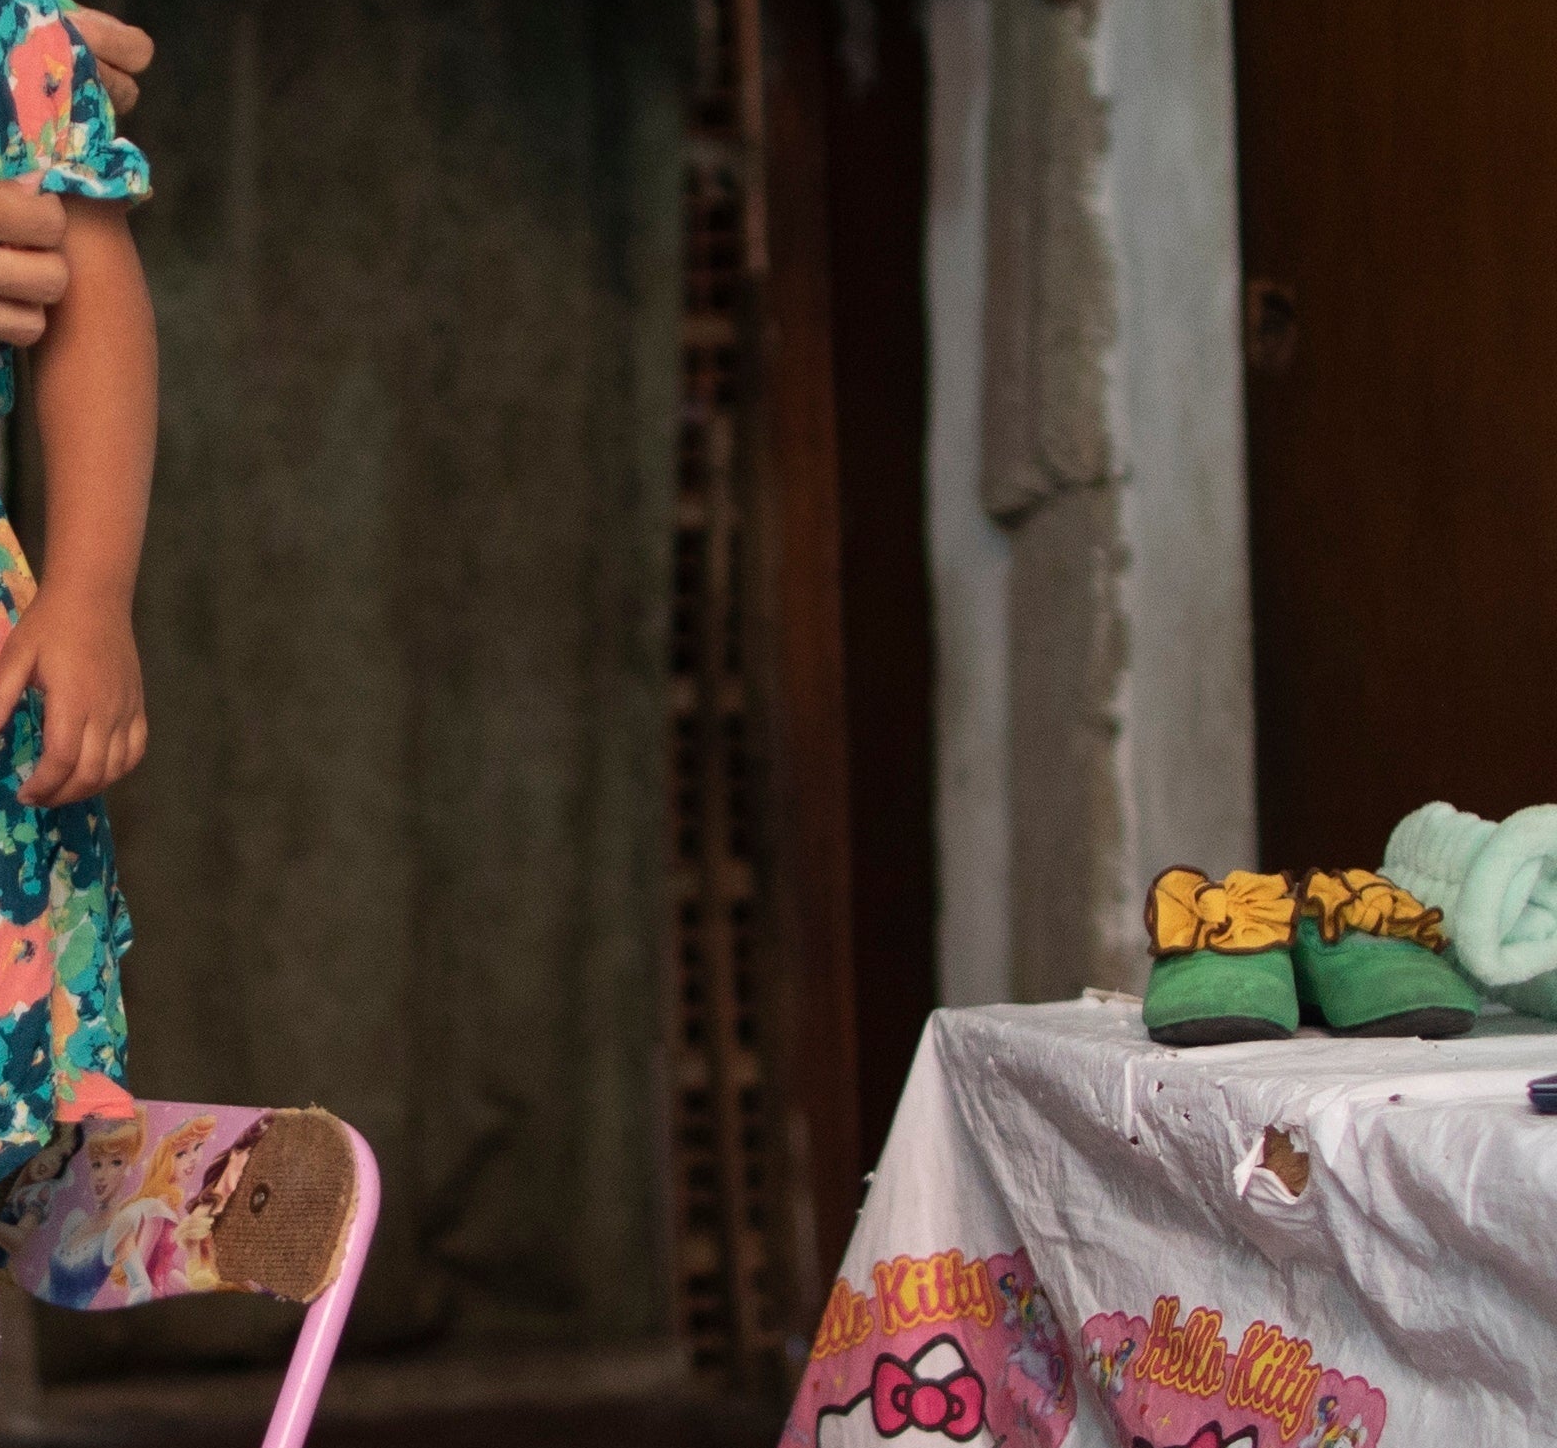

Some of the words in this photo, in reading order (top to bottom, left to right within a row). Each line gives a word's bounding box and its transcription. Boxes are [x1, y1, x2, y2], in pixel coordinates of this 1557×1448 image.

[873, 1249, 995, 1335] Kitty
[1137, 1294, 1227, 1399] Hello
[1226, 1320, 1322, 1441] Kitty
